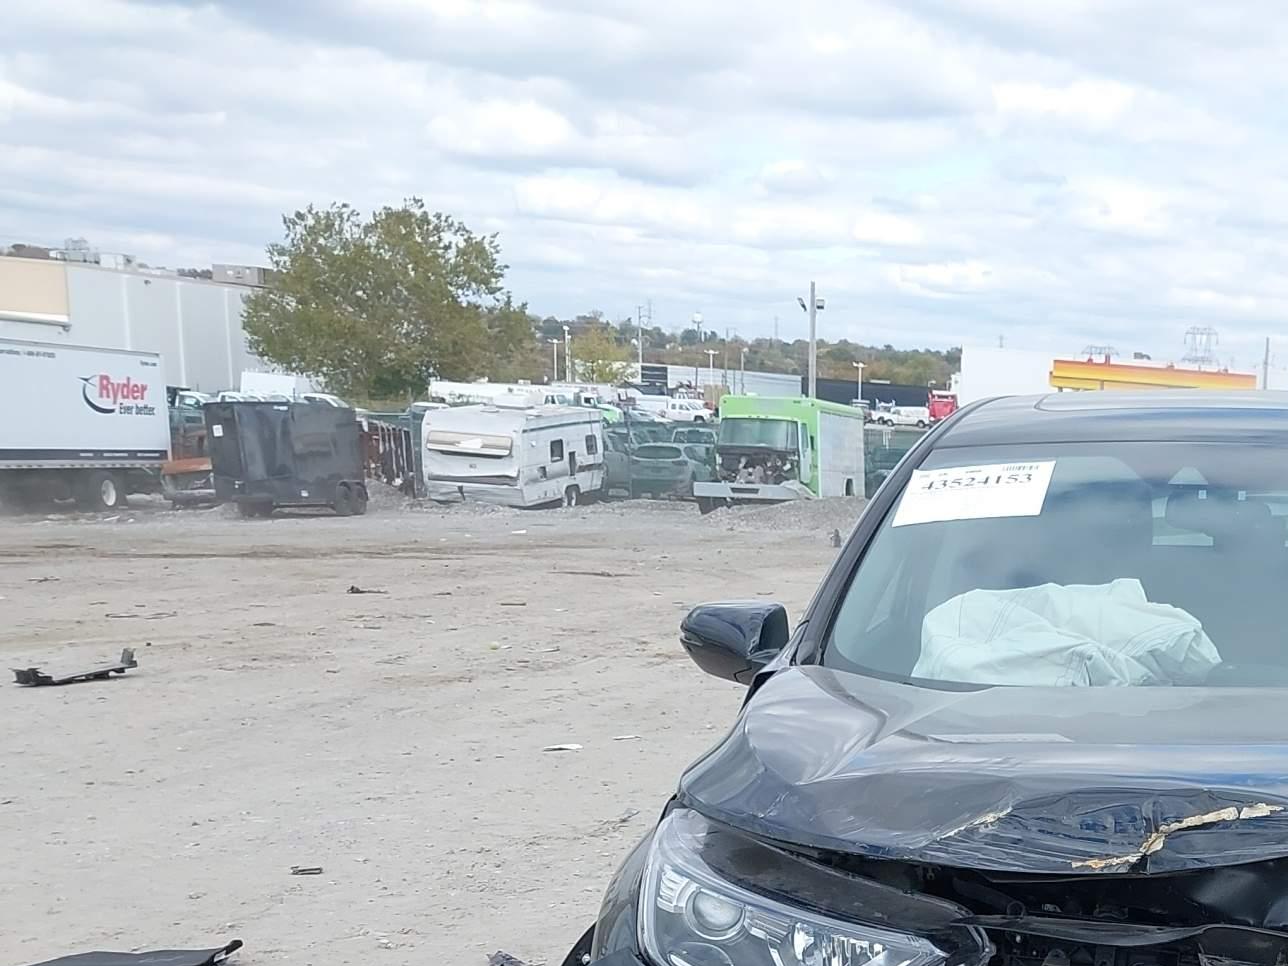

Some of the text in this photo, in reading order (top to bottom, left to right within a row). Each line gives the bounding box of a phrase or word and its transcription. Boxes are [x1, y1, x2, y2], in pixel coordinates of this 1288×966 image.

[98, 374, 148, 404] Ryder
[119, 403, 134, 415] Ever
[921, 473, 1033, 491] 43524153
